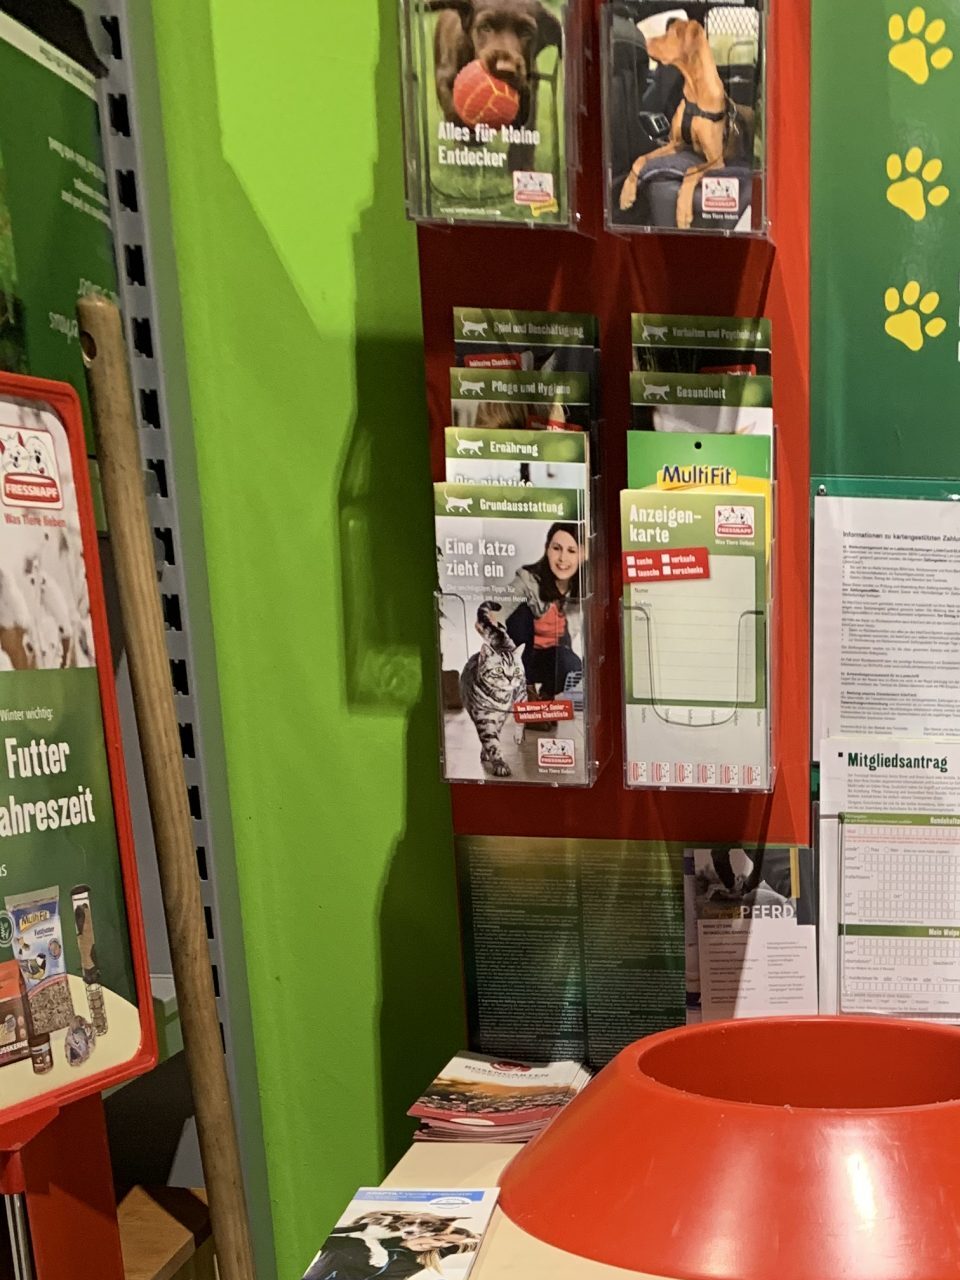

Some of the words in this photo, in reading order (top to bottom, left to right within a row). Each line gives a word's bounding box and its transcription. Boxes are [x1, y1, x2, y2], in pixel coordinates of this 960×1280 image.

[438, 122, 470, 141] Alles
[474, 122, 498, 144] für
[501, 124, 540, 145] kleine
[438, 147, 508, 168] Entdecker
[491, 380, 518, 395] Pflege
[520, 382, 536, 394] und
[676, 385, 726, 399] Gesundheit
[490, 442, 539, 457] Ernährung
[662, 465, 733, 486] MultiFit
[5, 482, 59, 499] FRESSNAPF
[479, 498, 564, 516] Grundausstattung
[630, 504, 702, 528] Anzeigen-
[630, 523, 670, 543] karte
[445, 537, 475, 555] Eine
[478, 539, 516, 558] Katze
[446, 560, 480, 579] zieht
[484, 562, 504, 579] ein
[0, 710, 24, 722] Winter
[4, 737, 70, 780] Futter
[848, 752, 948, 773] Mitgliedsantrag
[0, 785, 96, 838] ahreszeit
[740, 905, 794, 920] PFERD
